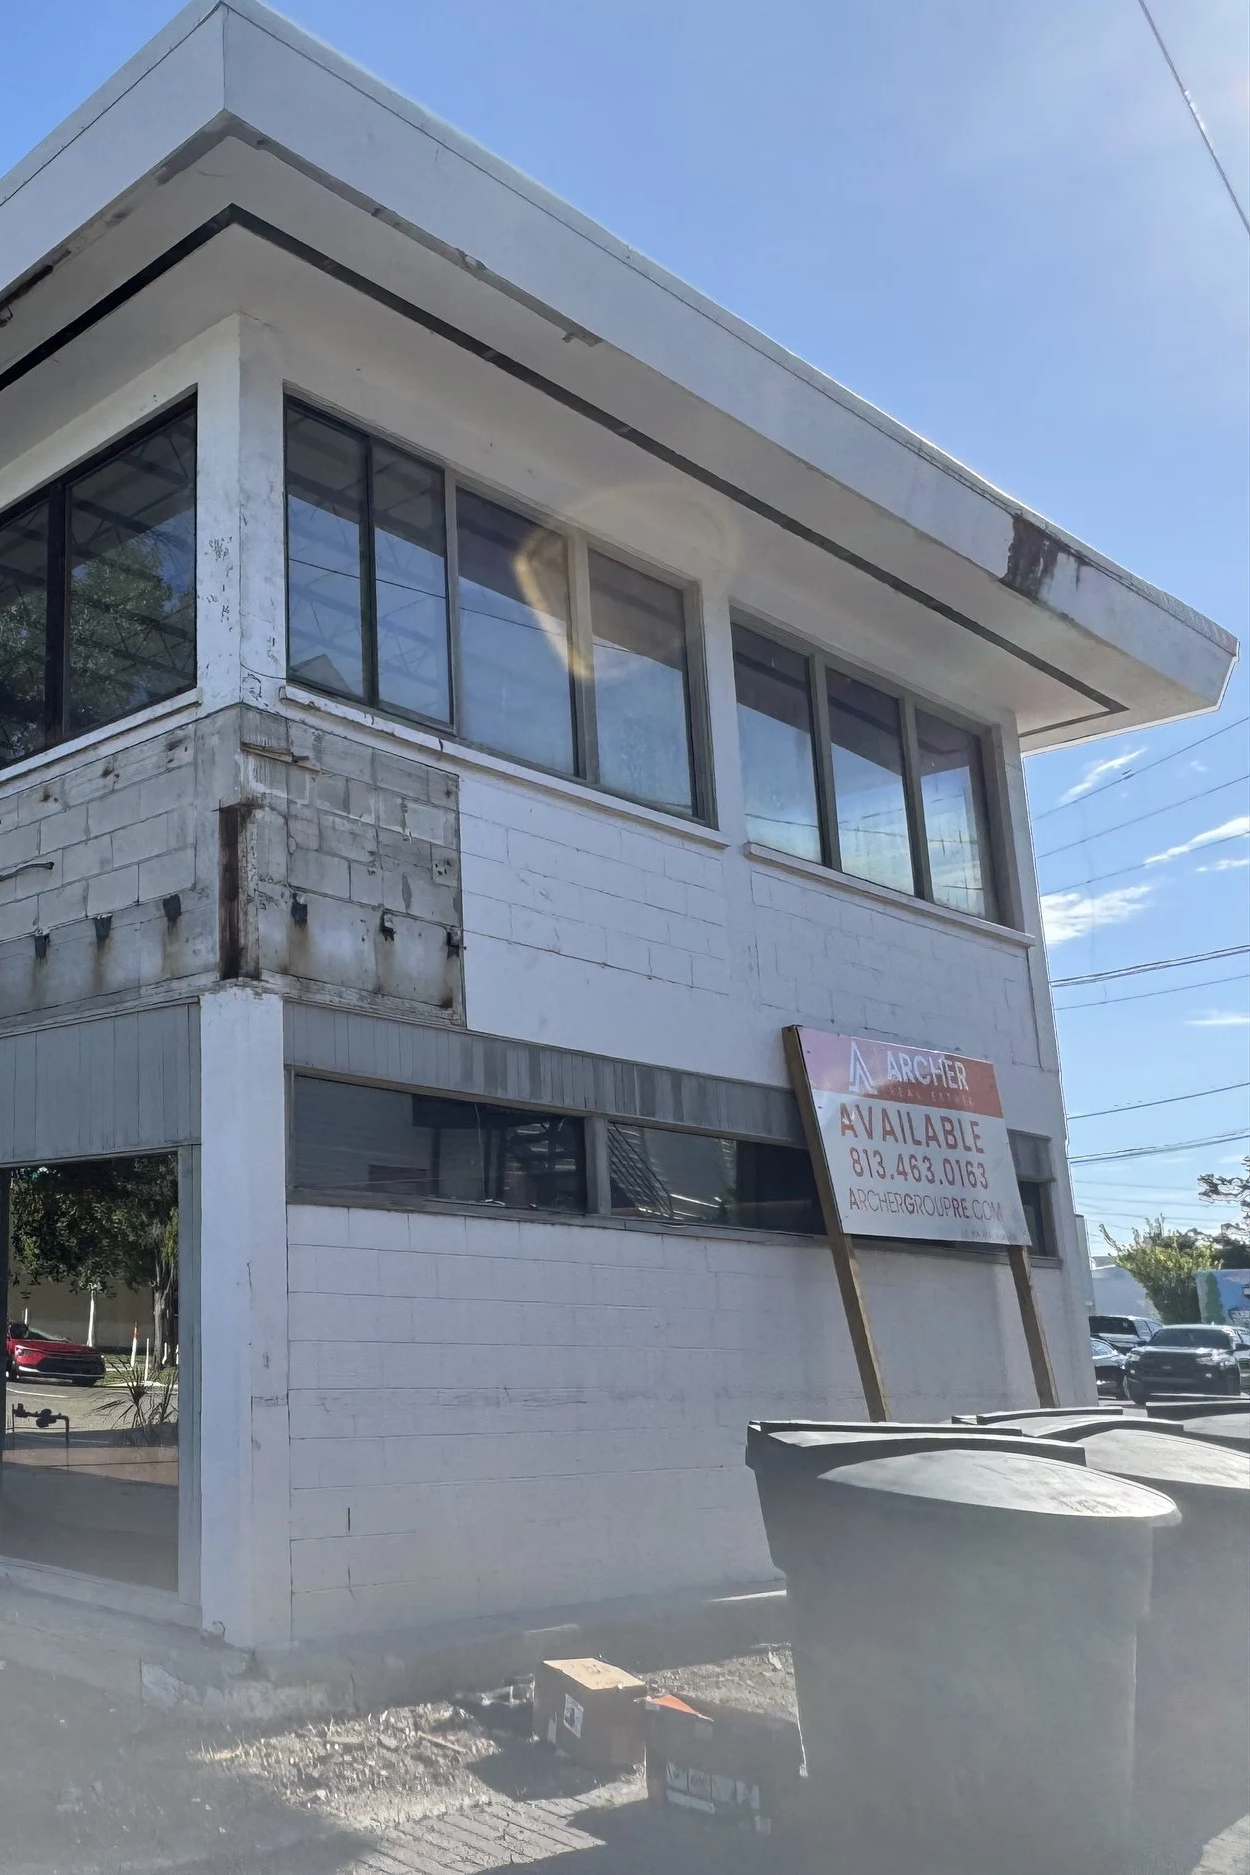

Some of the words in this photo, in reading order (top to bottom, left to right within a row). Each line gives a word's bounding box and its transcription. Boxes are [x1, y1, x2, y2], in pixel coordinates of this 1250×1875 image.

[886, 1050, 969, 1091] ARCHER
[840, 1103, 985, 1153] AVAILABLE
[850, 1147, 989, 1189] 813.463.0163
